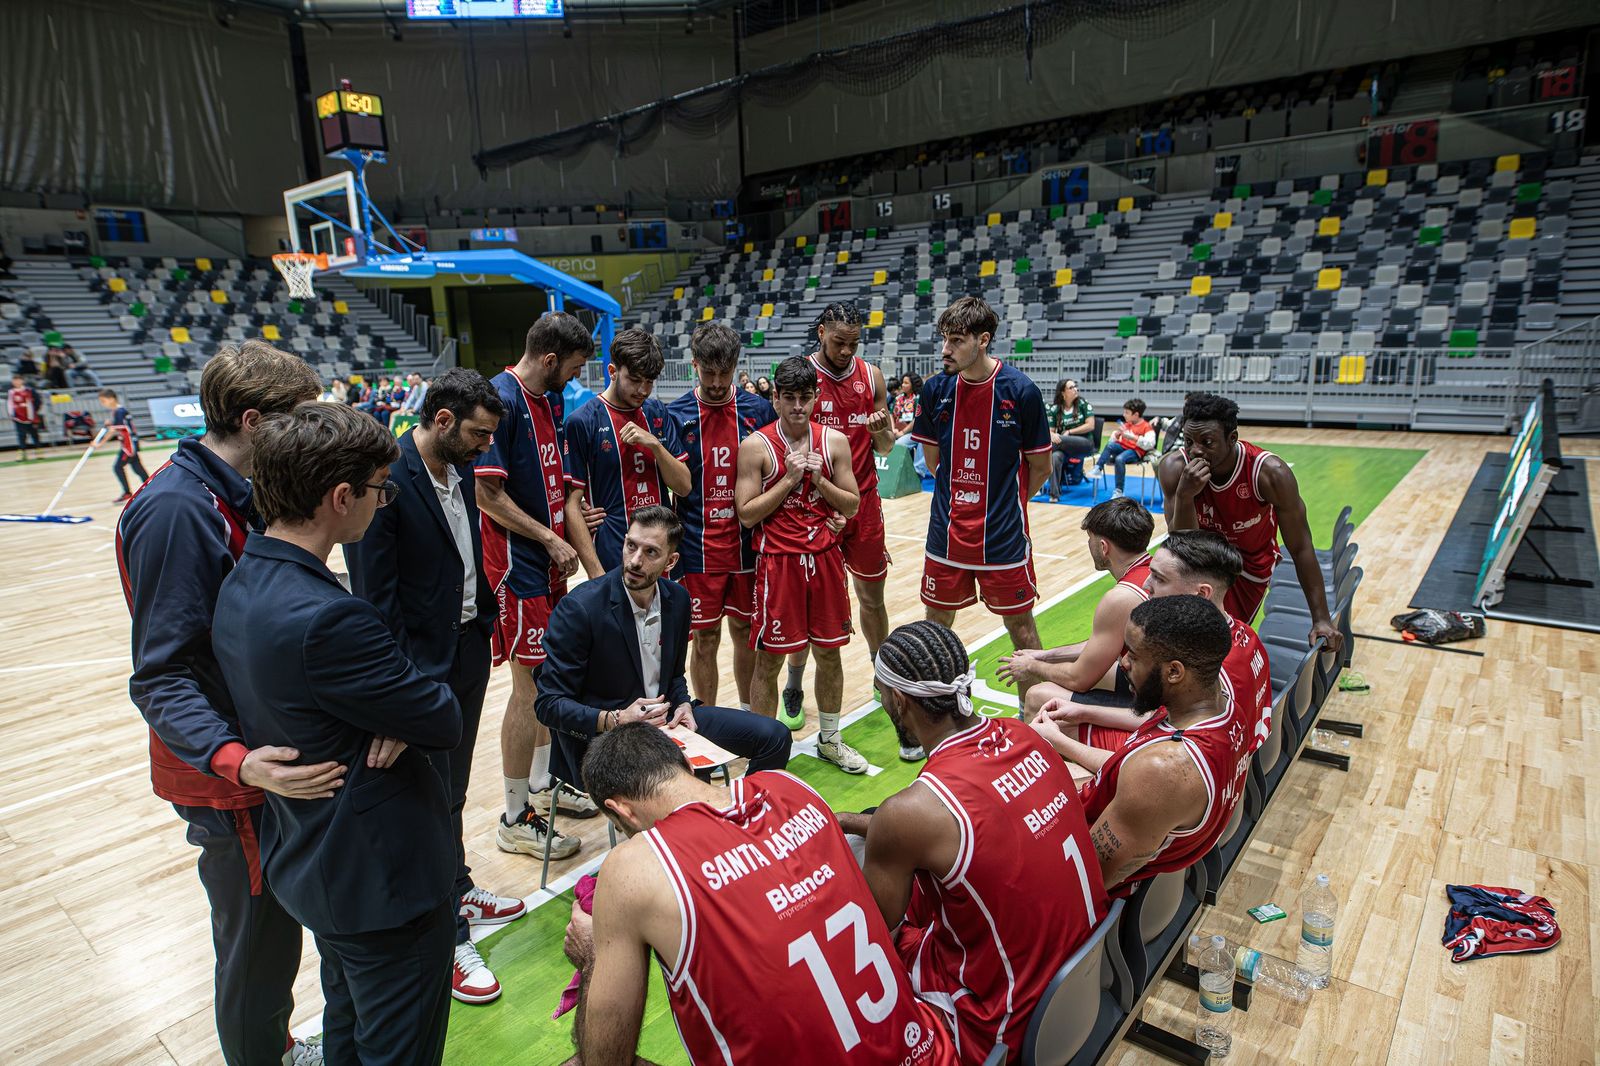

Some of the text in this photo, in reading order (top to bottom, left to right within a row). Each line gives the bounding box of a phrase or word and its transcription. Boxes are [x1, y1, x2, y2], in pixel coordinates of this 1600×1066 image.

[1367, 123, 1412, 138] Sector
[1551, 109, 1586, 134] 18
[1378, 119, 1438, 169] 18
[1041, 168, 1071, 180] Sector
[1048, 167, 1089, 205] 16
[877, 201, 892, 217] 15
[934, 194, 950, 210] 15
[821, 201, 850, 234] 14
[814, 413, 840, 424] Jaén
[963, 428, 980, 451] 15
[540, 442, 557, 467] 22
[633, 452, 646, 474] 5
[711, 446, 731, 468] 12
[957, 468, 981, 481] Jaén
[631, 493, 656, 508] Jaén
[709, 487, 735, 499] Jaén
[925, 574, 936, 591] 15
[772, 619, 782, 635] 2
[991, 750, 1051, 803] FELIZOR
[1023, 790, 1069, 833] Blanca
[1096, 827, 1116, 857] TO BE
[1101, 820, 1122, 849] BORN
[701, 843, 771, 890] SANTA
[765, 862, 835, 912] Blanca
[1062, 833, 1097, 929] 1
[778, 894, 817, 921] impresores
[788, 901, 899, 1053] 13
